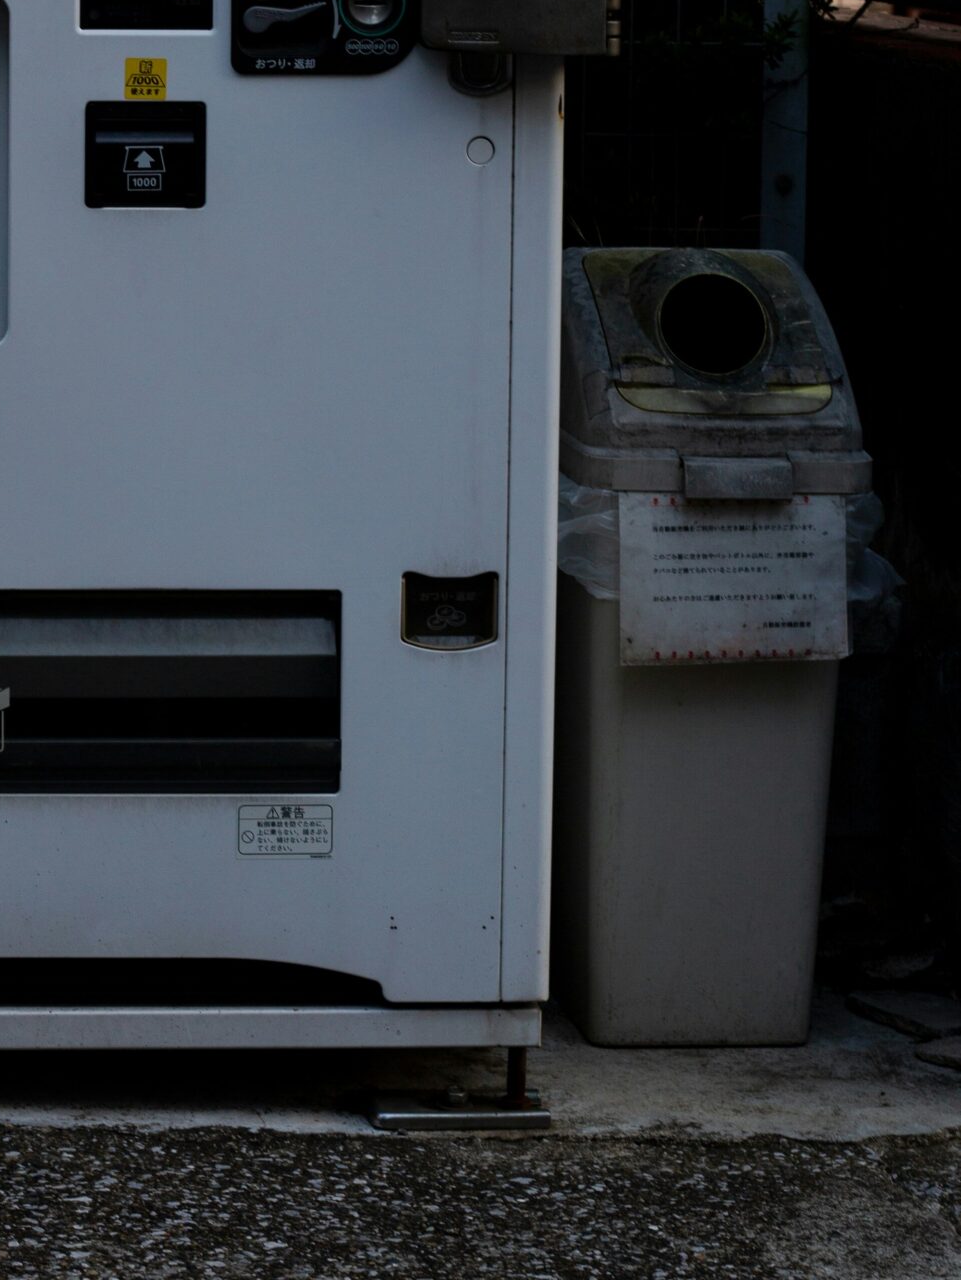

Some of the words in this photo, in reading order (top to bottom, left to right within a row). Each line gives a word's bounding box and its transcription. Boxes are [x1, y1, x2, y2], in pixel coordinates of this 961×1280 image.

[255, 58, 316, 69] おつり・返却
[131, 76, 159, 85] 1000
[131, 87, 160, 96] 使えます
[132, 177, 157, 188] 1000
[281, 806, 305, 819] 警告
